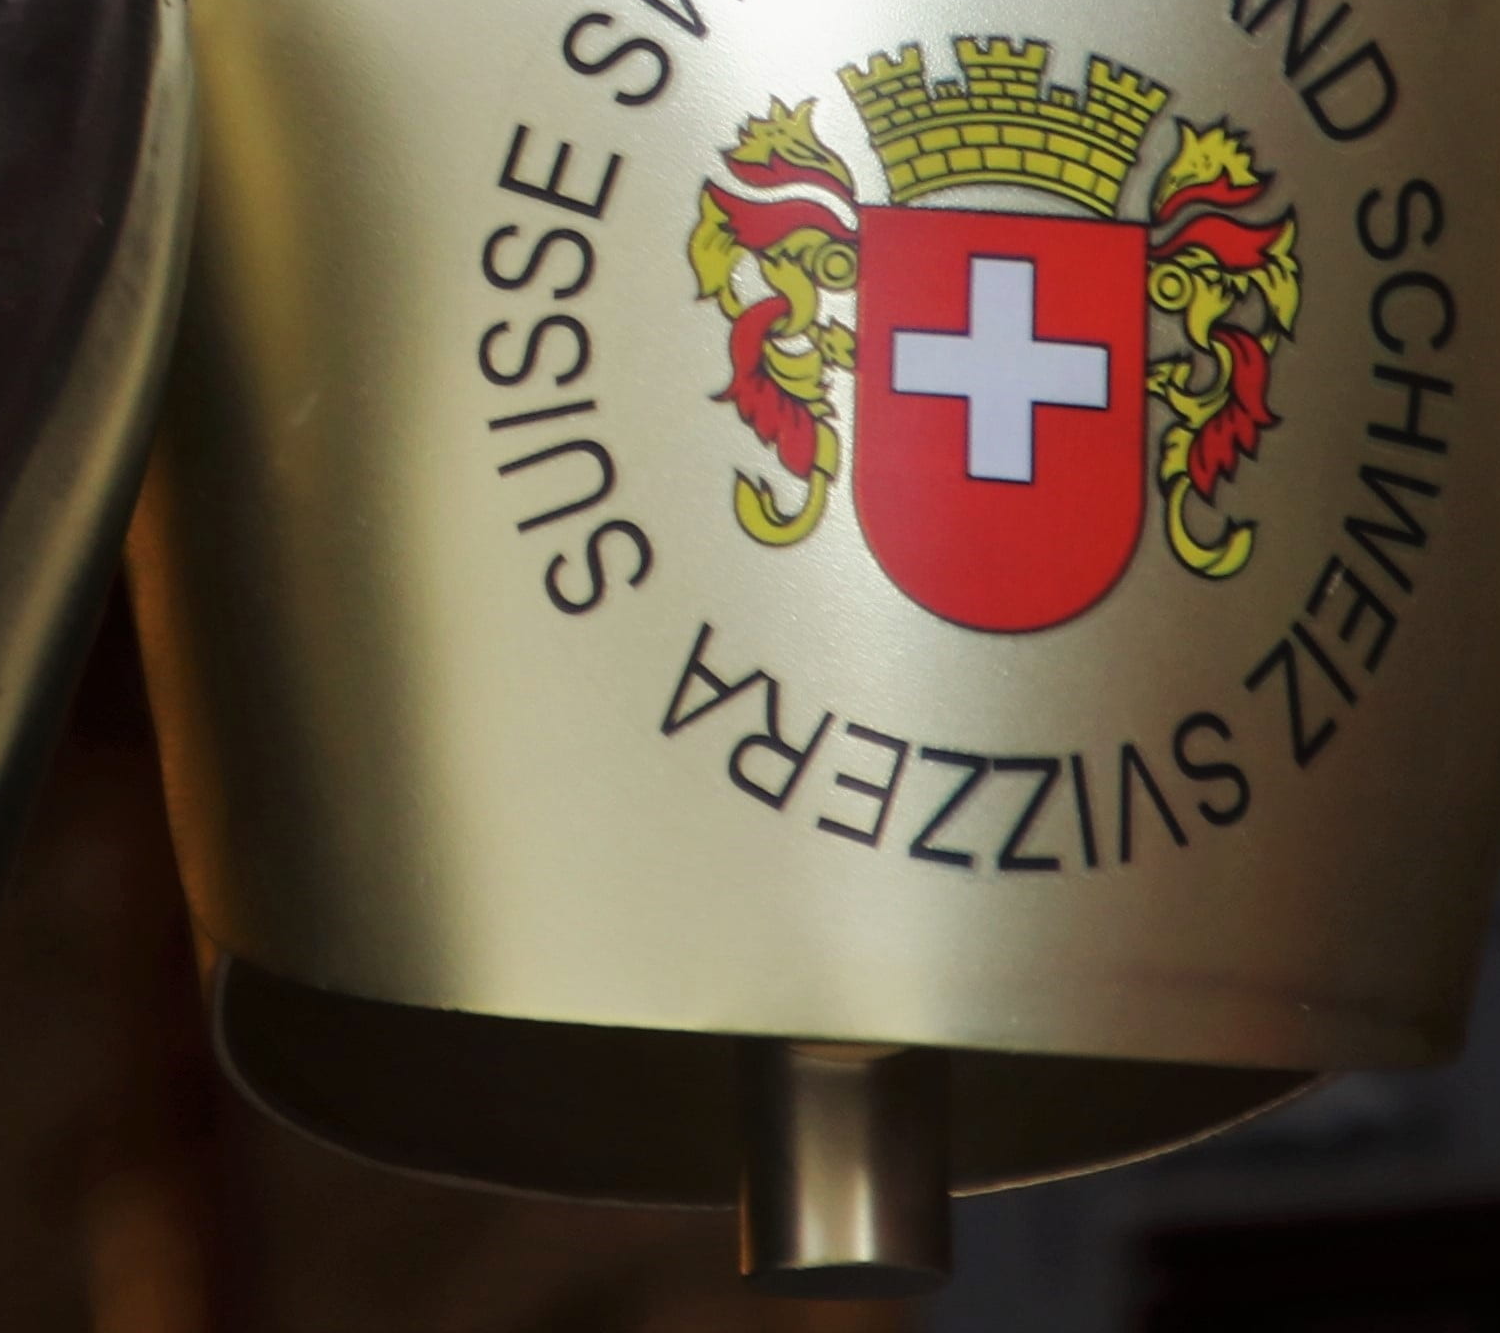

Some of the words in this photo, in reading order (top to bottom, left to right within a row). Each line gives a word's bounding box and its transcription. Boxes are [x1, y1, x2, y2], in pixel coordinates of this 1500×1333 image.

[478, 123, 655, 618] SUISSE
[1244, 177, 1458, 769] SCHWEIZ
[658, 621, 1252, 874] SVIZZERA
